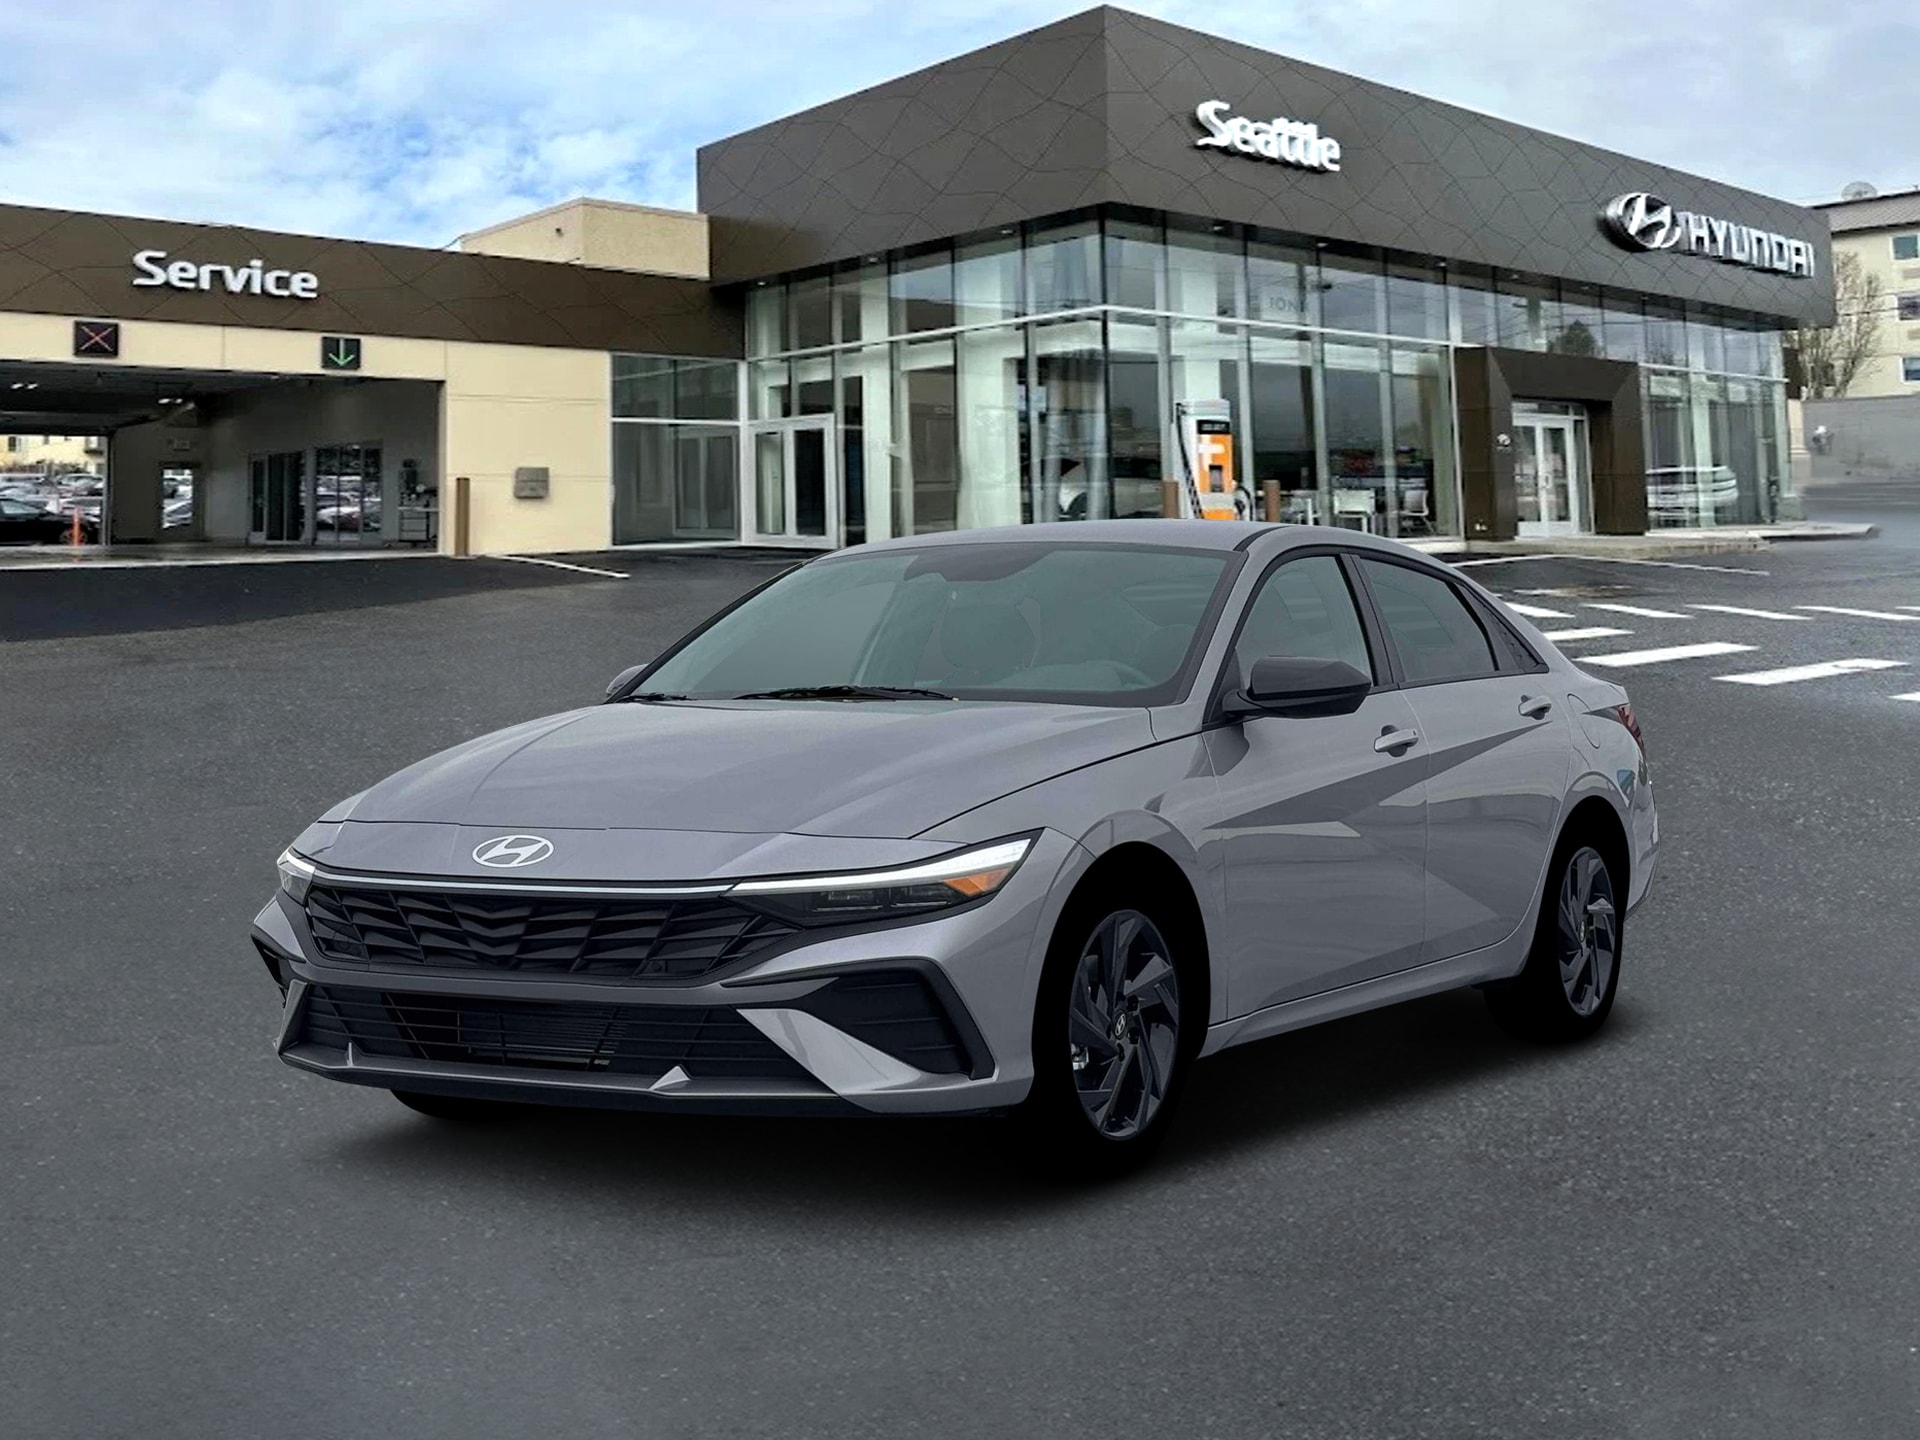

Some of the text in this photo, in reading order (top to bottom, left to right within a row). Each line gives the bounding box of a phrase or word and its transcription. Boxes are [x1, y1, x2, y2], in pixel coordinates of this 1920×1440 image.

[1197, 100, 1341, 171] Seattle
[132, 250, 319, 298] Service
[1681, 212, 1815, 277] HYUNDAI
